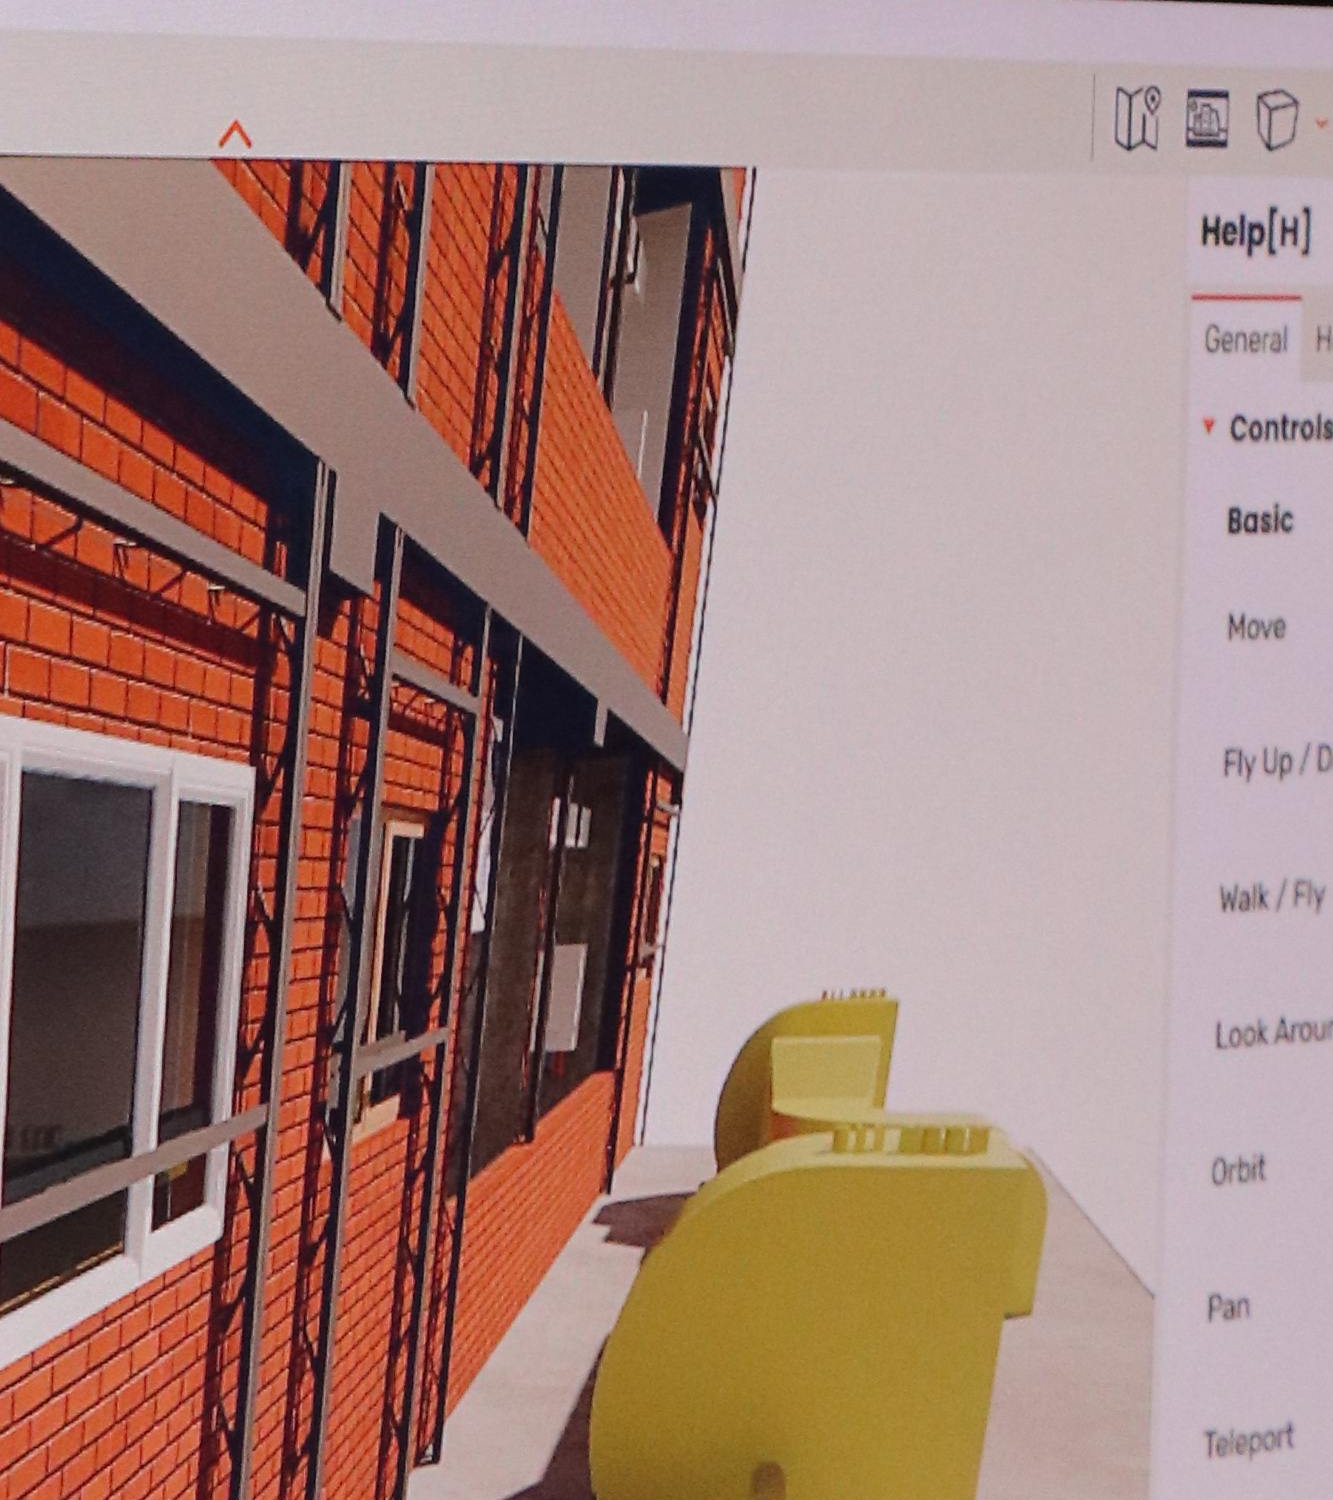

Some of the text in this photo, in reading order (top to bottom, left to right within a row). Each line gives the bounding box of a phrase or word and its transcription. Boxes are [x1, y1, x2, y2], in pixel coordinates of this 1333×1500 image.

[1202, 206, 1311, 256] Help[H]
[1204, 325, 1288, 354] General
[1227, 505, 1294, 536] Basic
[1227, 612, 1286, 641] Move
[1224, 748, 1256, 783] Fly
[1263, 747, 1293, 780] Up
[1299, 742, 1311, 775] /
[1220, 878, 1325, 914] Walk / Fly
[1215, 1019, 1267, 1049] Look
[1212, 1155, 1266, 1187] Orbit
[1208, 1295, 1250, 1324] Pan
[1205, 1421, 1295, 1463] Teleport
